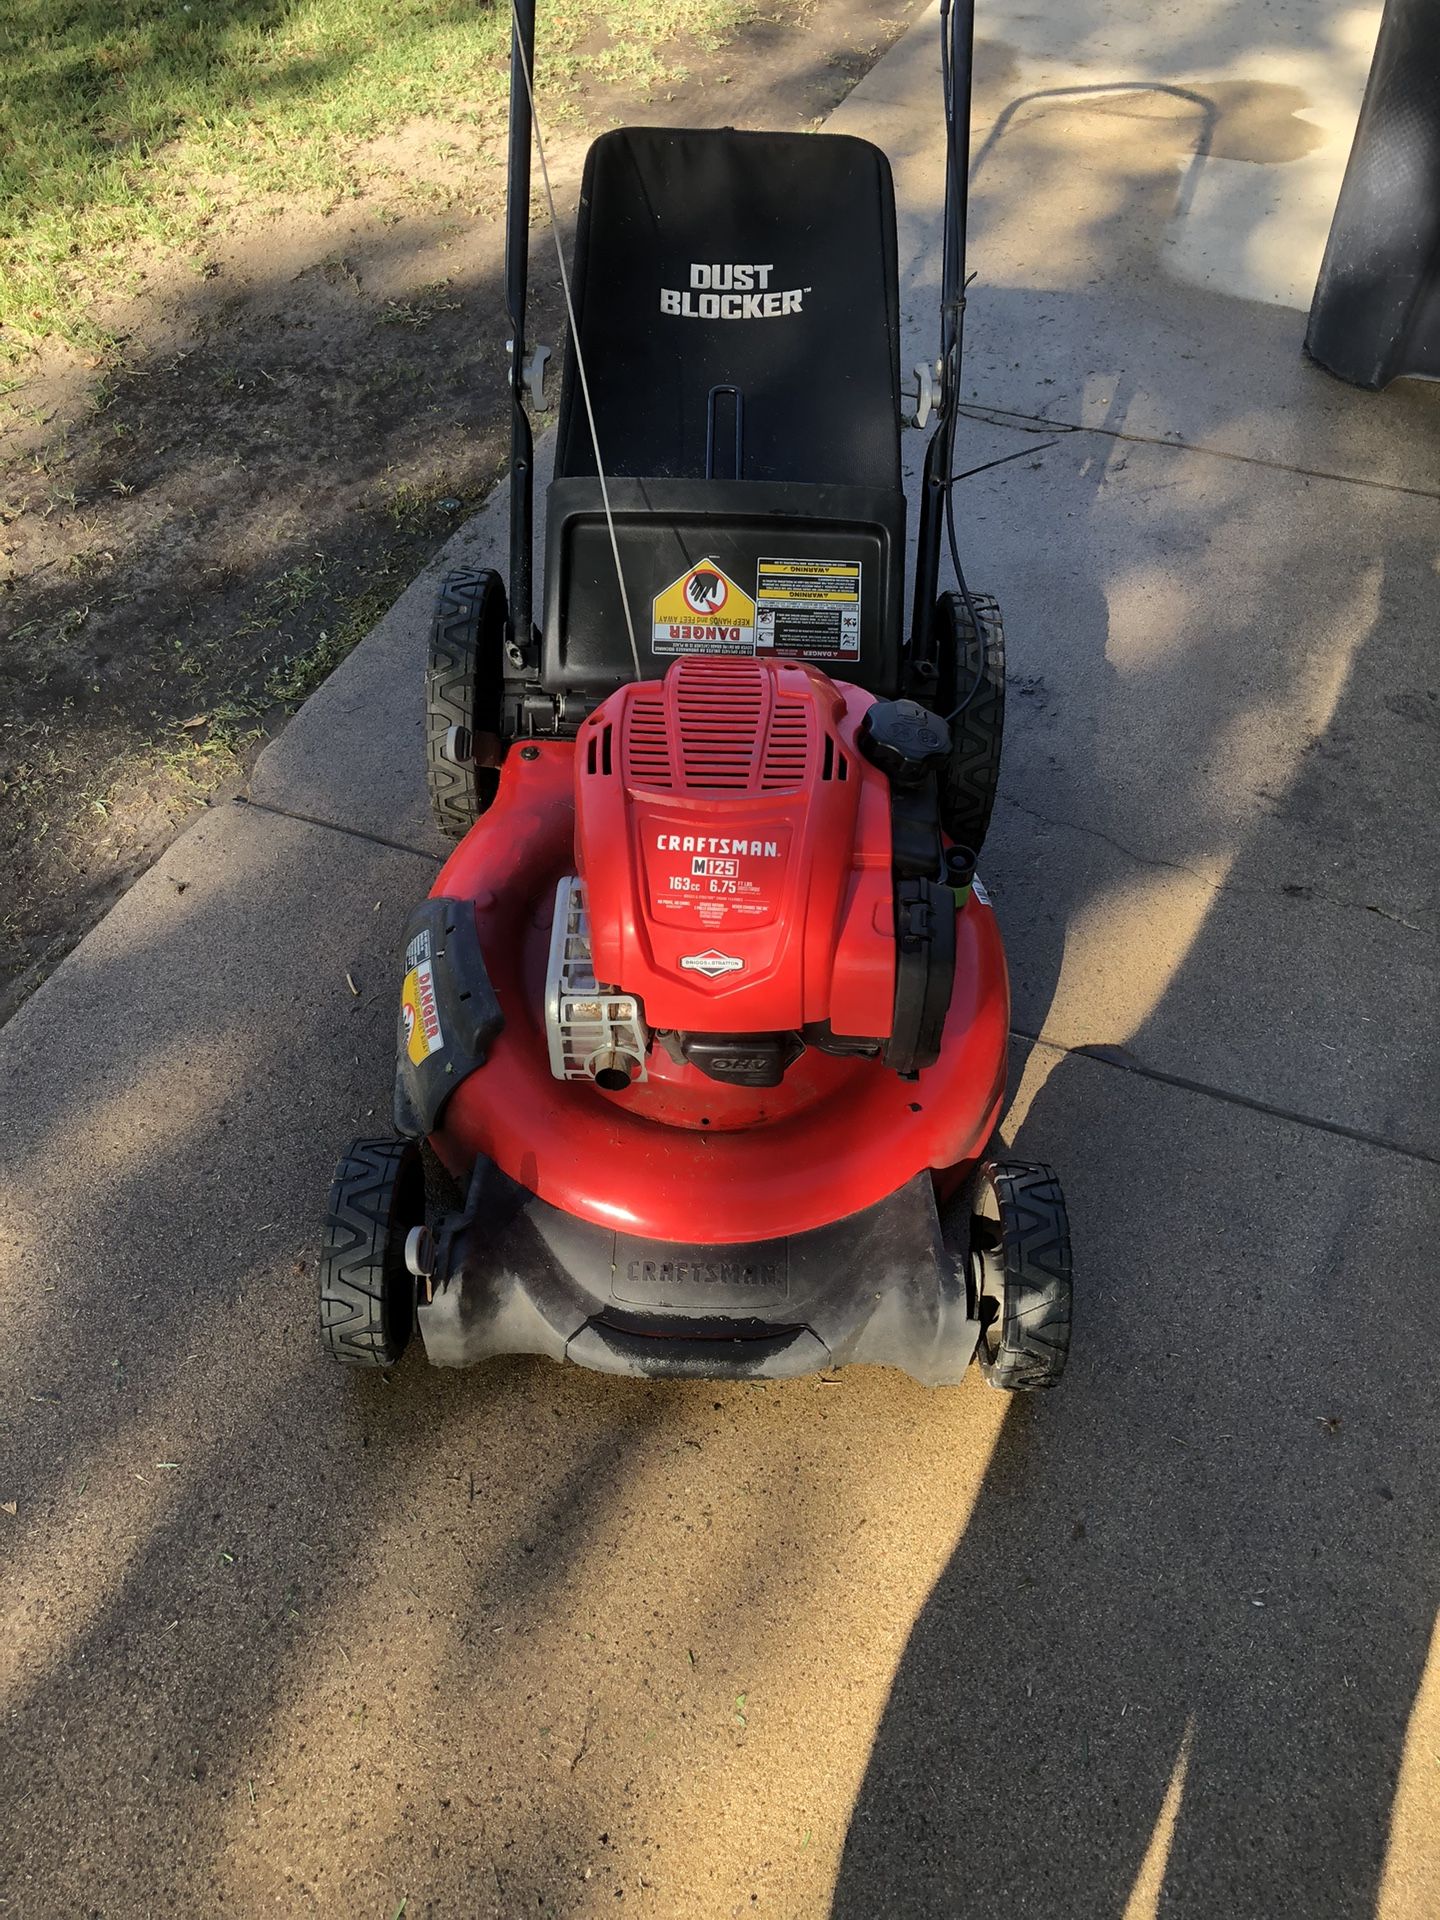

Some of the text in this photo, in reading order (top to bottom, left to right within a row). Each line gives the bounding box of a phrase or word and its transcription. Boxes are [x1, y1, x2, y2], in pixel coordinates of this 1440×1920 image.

[690, 264, 773, 290] DUST
[660, 287, 803, 319] BLOCKER
[710, 617, 731, 625] HANDS
[670, 626, 740, 640] DANGER
[657, 834, 777, 857] CRAFTSMAN
[693, 859, 735, 876] M125
[710, 880, 736, 893] 6.75
[419, 973, 439, 1039] DANGER
[626, 1260, 777, 1286] CRAFTSMAN
